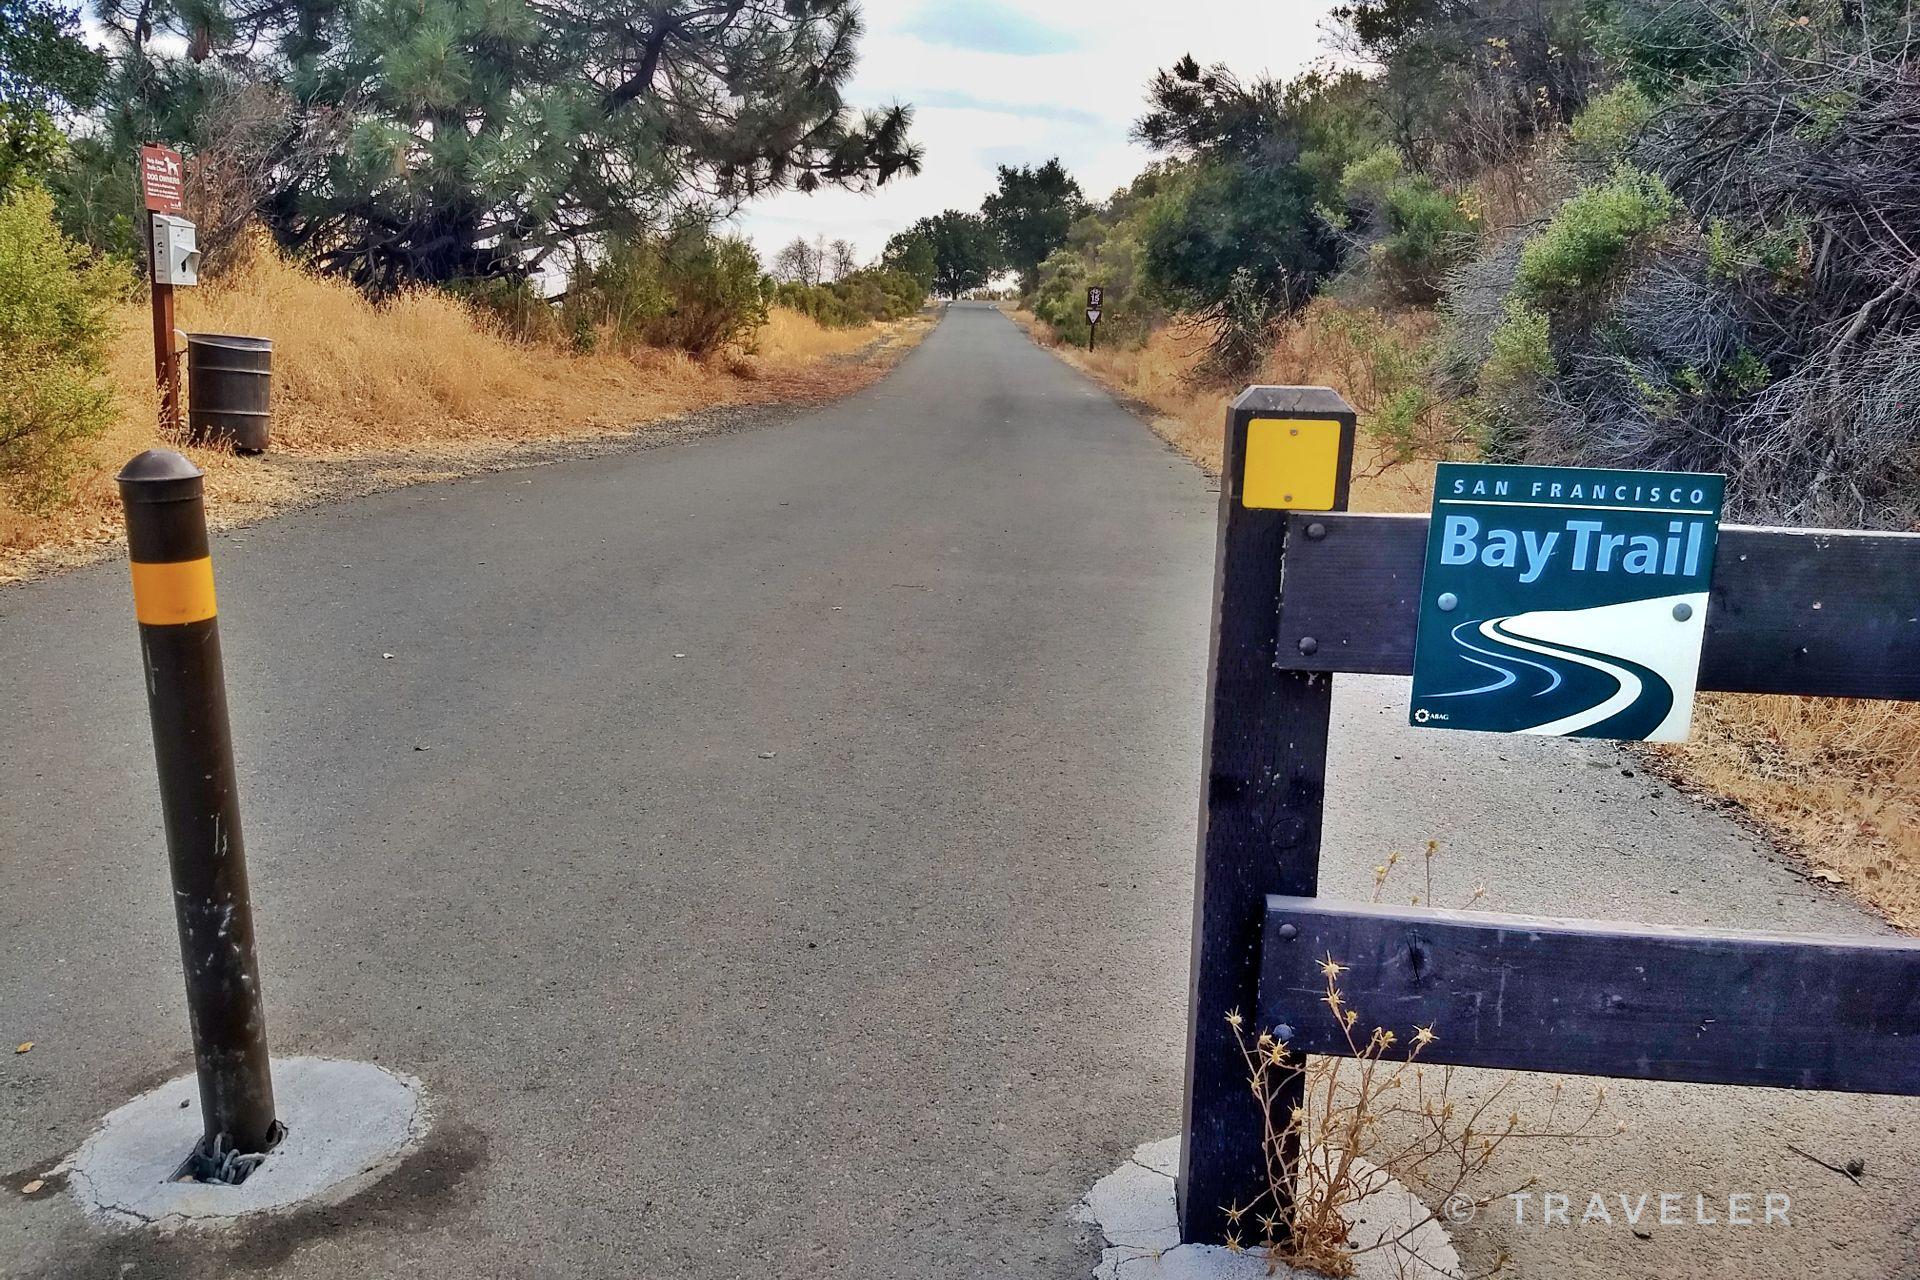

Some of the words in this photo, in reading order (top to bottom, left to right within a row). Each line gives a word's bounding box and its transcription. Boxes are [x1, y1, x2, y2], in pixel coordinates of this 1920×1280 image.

[147, 173, 158, 181] DOG
[159, 174, 180, 185] OWNERS
[1453, 479, 1509, 496] SAN
[1531, 482, 1704, 504] FRANCISCO
[1440, 515, 1560, 583] Bay
[1566, 520, 1704, 577] Trail
